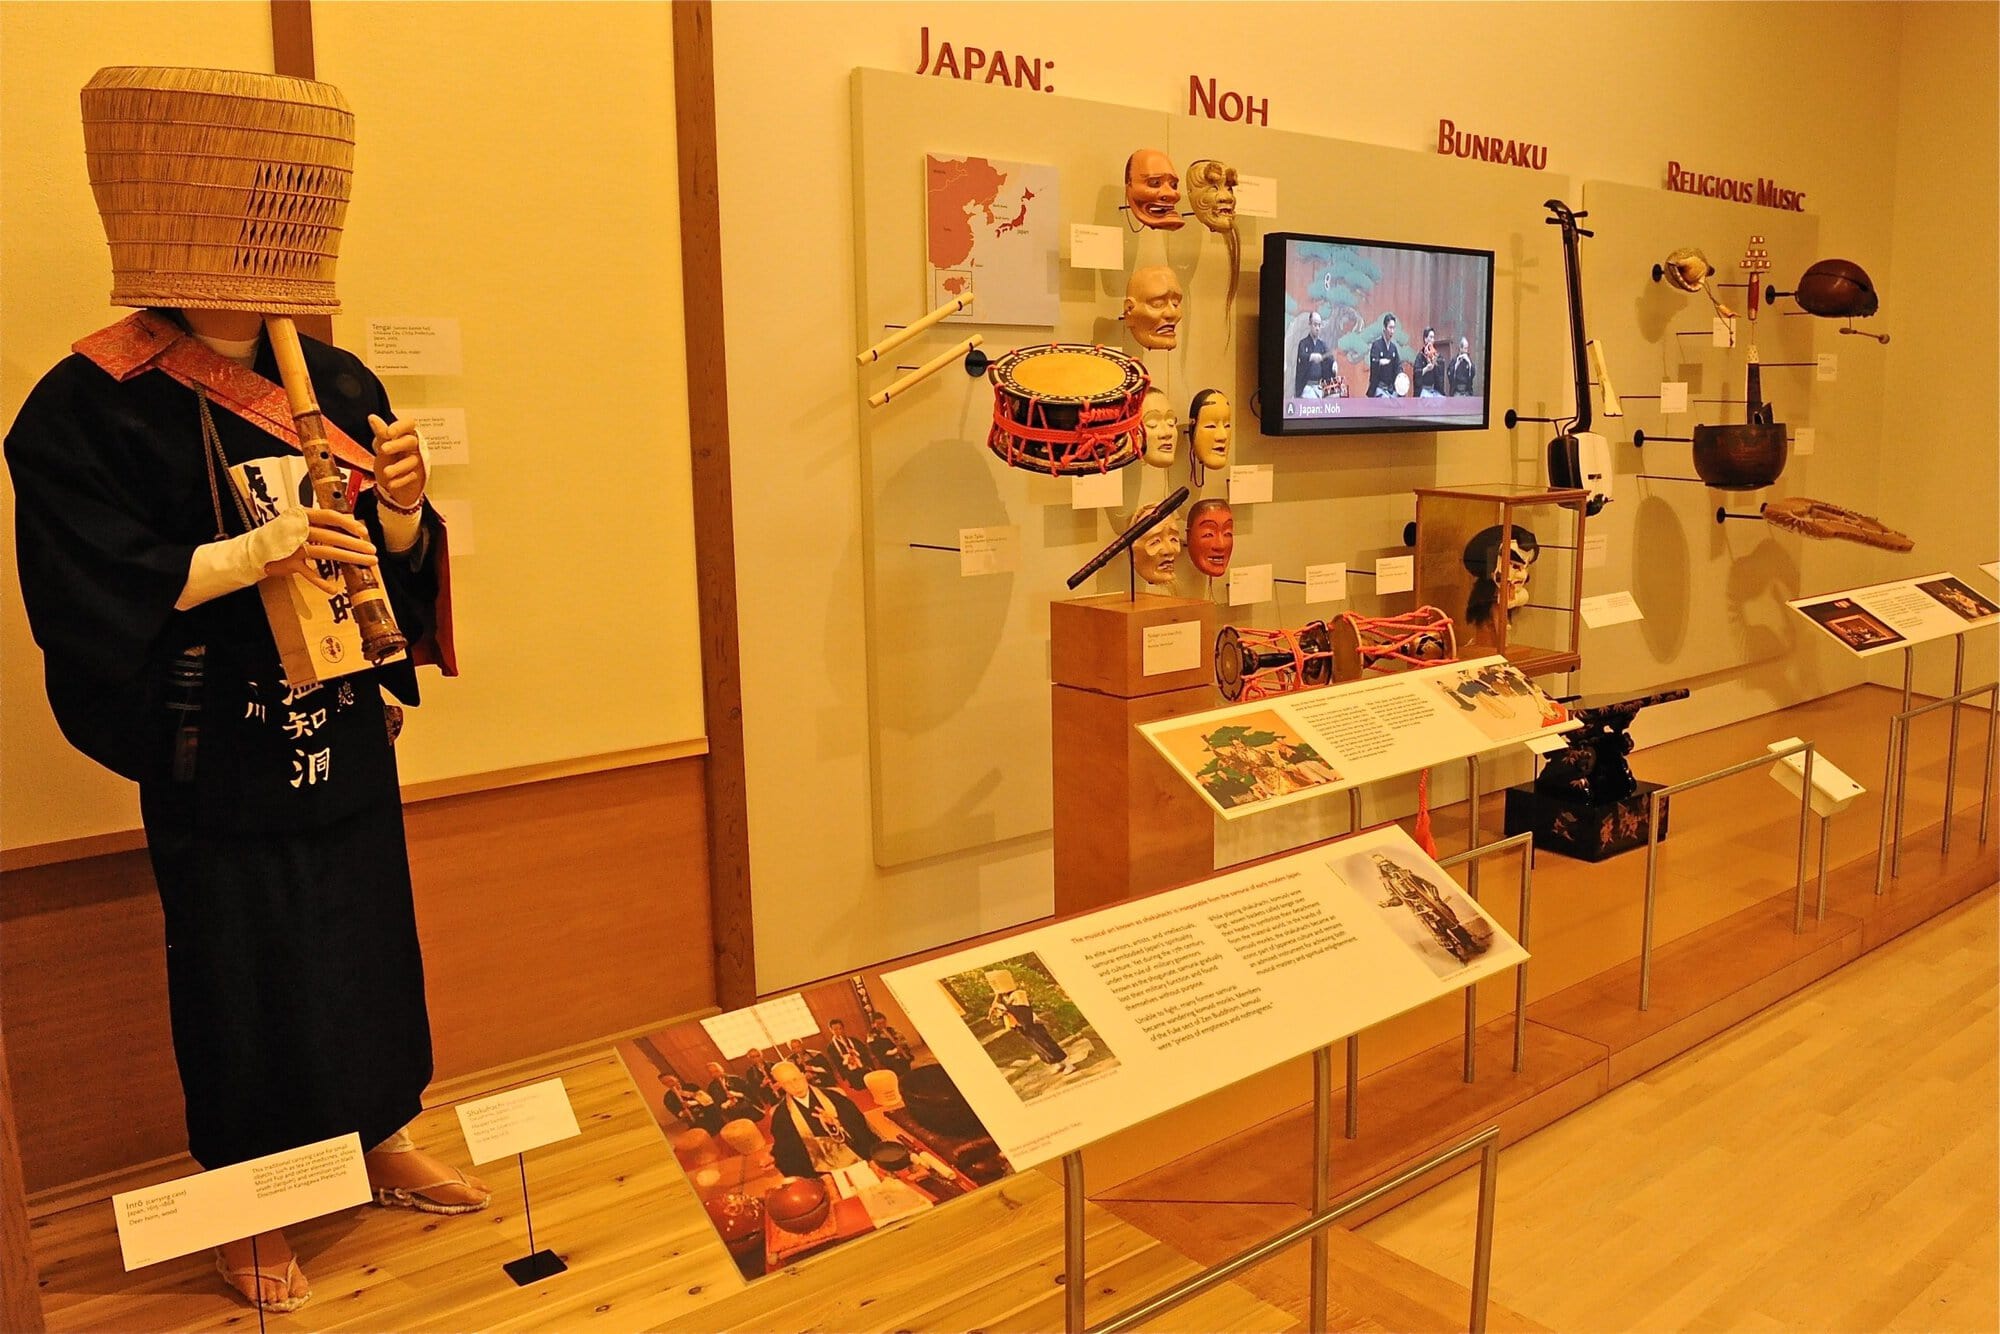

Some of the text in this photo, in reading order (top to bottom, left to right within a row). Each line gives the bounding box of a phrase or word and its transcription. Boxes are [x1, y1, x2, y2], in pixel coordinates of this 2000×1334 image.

[1300, 404, 1323, 416] Japan:
[1325, 403, 1341, 414] Noh
[1223, 909, 1242, 918] playing
[1245, 911, 1265, 919] baskets
[1265, 905, 1280, 913] called
[1291, 901, 1320, 913] detachment
[1250, 927, 1271, 936] material
[1257, 947, 1269, 955] part
[1274, 939, 1296, 948] Japanese
[1323, 923, 1342, 931] remains
[1283, 923, 1310, 935] shakuhachi
[1309, 918, 1329, 926] became
[1091, 957, 1115, 968] samurai
[1143, 942, 1164, 951] Japan's
[1164, 933, 1193, 945] spirituality
[1141, 954, 1162, 962] during
[1256, 954, 1278, 964] admired
[1277, 945, 1304, 957] instrument
[1312, 935, 1335, 945] achieving
[1256, 965, 1275, 975] musical
[1275, 959, 1296, 968] mastery
[1305, 948, 1324, 957] spiritual
[1105, 977, 1123, 985] under
[1152, 960, 1175, 969] military
[1173, 951, 1201, 963] governors
[1110, 985, 1131, 993] known
[1177, 961, 1199, 971] samurai
[1199, 954, 1224, 966] gradually
[1117, 994, 1130, 1002] lost
[1129, 990, 1144, 998] their
[1144, 983, 1168, 993] military
[1165, 975, 1190, 985] function
[1200, 965, 1219, 974] found
[1124, 997, 1158, 1010] themselves
[1158, 988, 1180, 999] without
[1134, 1013, 1157, 1023] Unable
[1194, 993, 1215, 1002] former
[1215, 984, 1237, 995] samurai
[1141, 1021, 1166, 1032] became
[1165, 1011, 1196, 1023] wandering
[1235, 987, 1261, 998] Members
[1156, 1042, 1171, 1050] were
[1171, 1034, 1194, 1045] "priests
[1200, 1020, 1229, 1033] emptiness
[1181, 1021, 1194, 1029] sect
